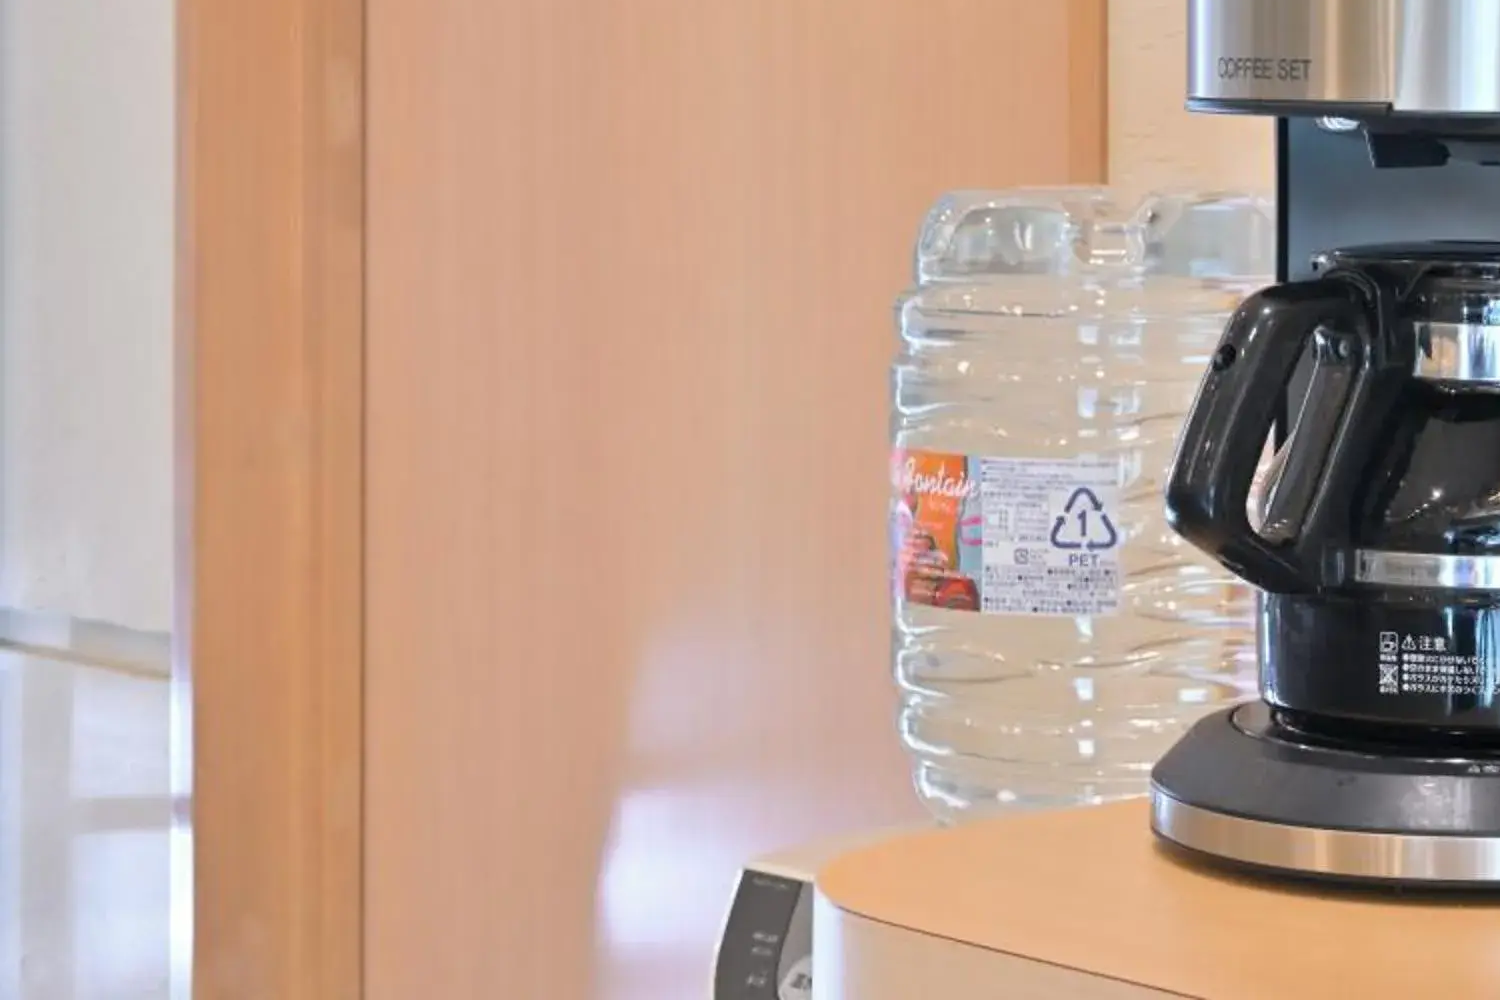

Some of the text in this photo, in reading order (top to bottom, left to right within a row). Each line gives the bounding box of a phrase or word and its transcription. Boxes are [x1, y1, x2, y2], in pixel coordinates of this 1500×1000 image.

[1217, 56, 1313, 81] COFFEE SET
[1078, 509, 1087, 538] 1
[1068, 553, 1101, 568] PET
